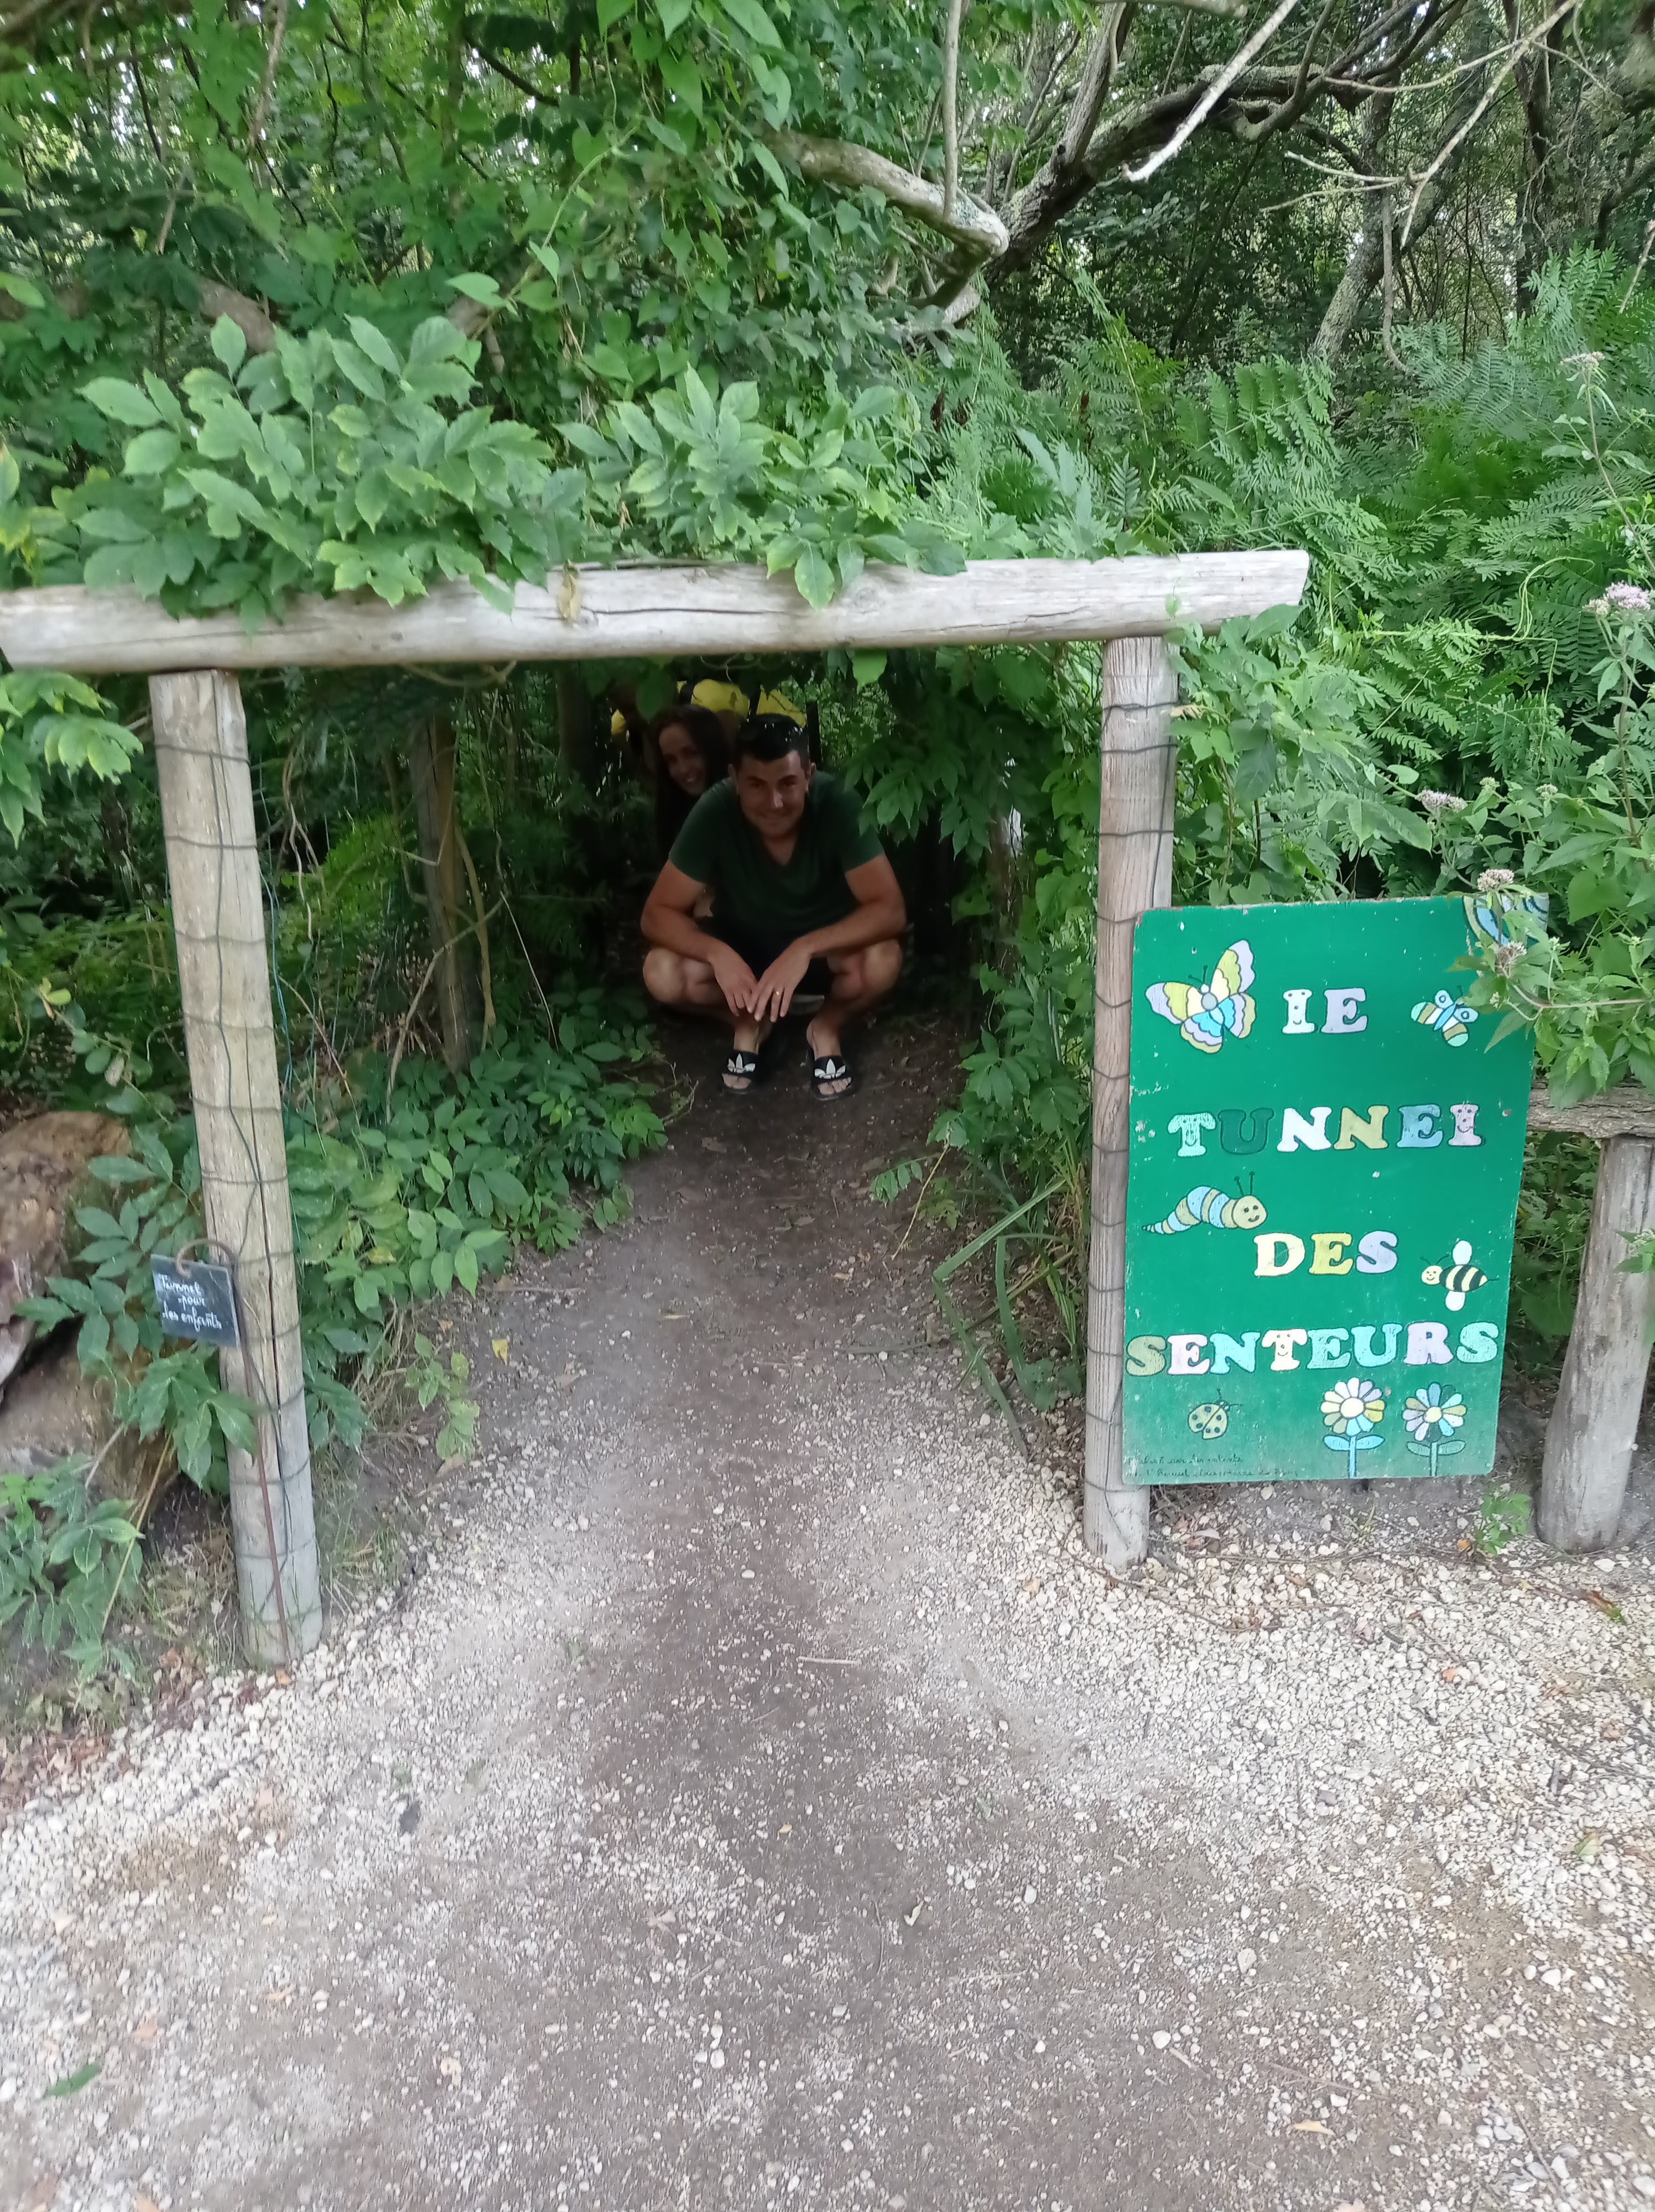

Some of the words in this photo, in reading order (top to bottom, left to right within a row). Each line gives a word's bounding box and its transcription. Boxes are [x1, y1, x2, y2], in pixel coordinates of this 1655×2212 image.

[1252, 1229, 1399, 1279] DES
[158, 1273, 204, 1297] Tunnel
[162, 1300, 179, 1322] les
[181, 1306, 222, 1333] enfants
[178, 1295, 206, 1311] pour
[1125, 1320, 1500, 1377] SENTEURS
